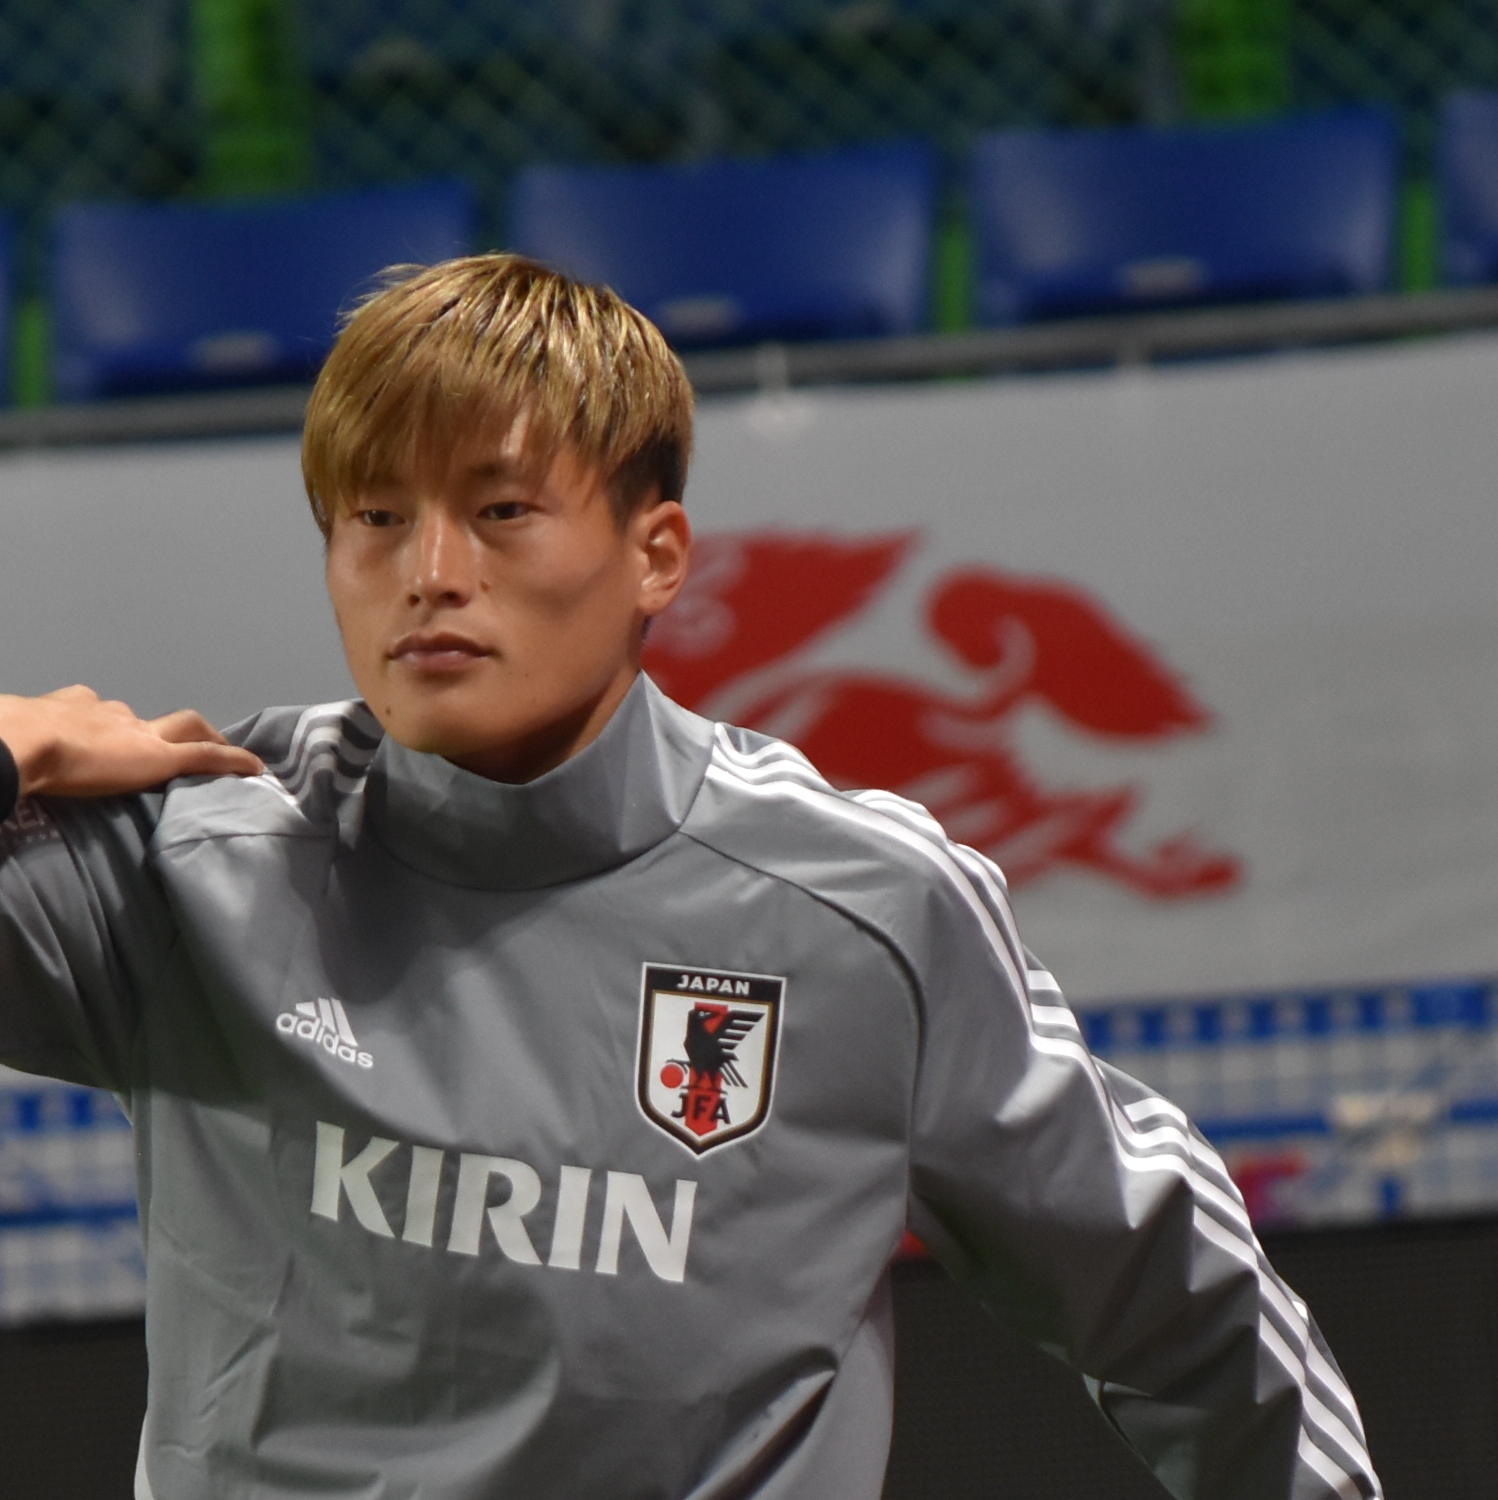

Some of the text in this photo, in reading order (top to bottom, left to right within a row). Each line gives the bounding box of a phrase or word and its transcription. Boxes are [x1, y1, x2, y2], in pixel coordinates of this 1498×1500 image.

[676, 973, 751, 996] JAPAN
[275, 1011, 374, 1069] adidas
[670, 1092, 732, 1125] JFA
[310, 1120, 698, 1283] KIRIN
